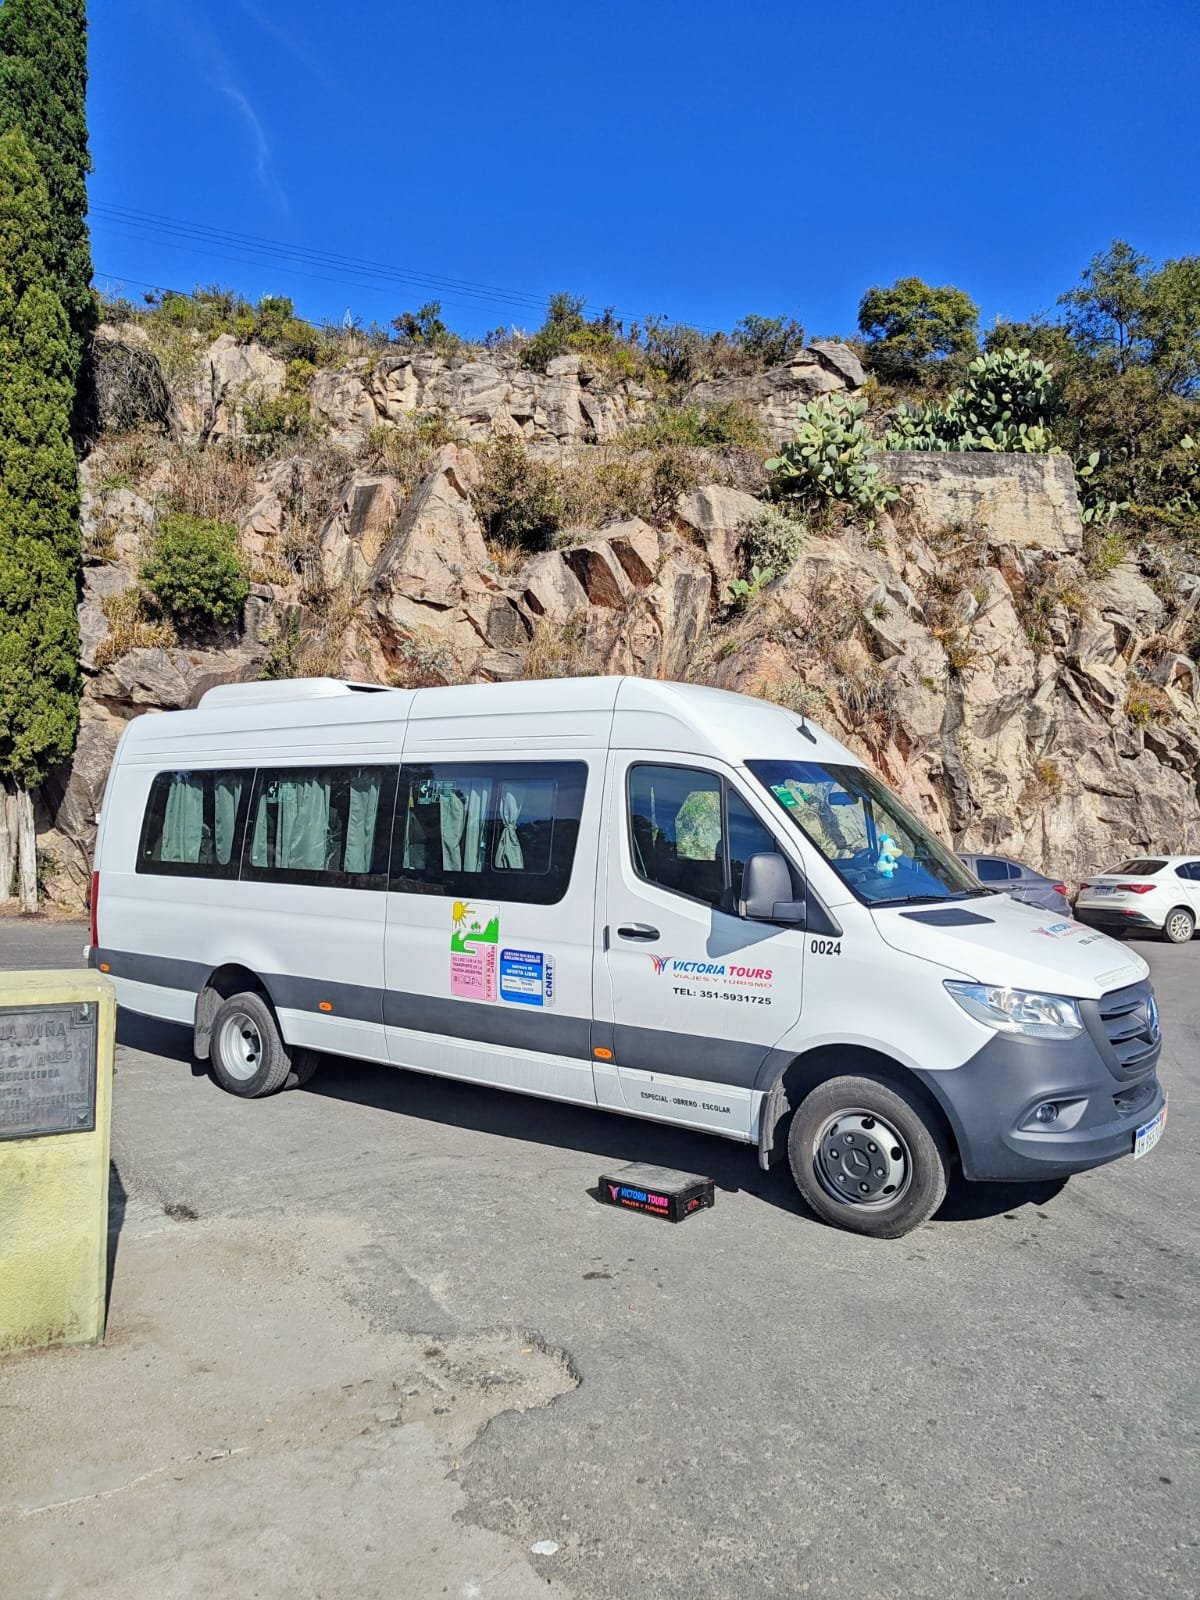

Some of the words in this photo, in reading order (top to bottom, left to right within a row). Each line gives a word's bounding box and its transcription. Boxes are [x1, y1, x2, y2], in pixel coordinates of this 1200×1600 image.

[810, 940, 841, 956] 0024
[672, 960, 726, 976] VICTORIA
[729, 966, 774, 980] TOURS
[545, 964, 553, 997] CNRT
[673, 973, 710, 982] VIAJES
[723, 979, 773, 988] TURISMO
[672, 987, 697, 997] TEL:
[700, 990, 772, 1005] 351-5931725
[640, 1092, 669, 1103] ESPECIAL
[673, 1097, 698, 1108] OBRERO
[702, 1102, 731, 1114] ESCOLAR
[620, 1187, 647, 1202] VICTORIA
[648, 1194, 668, 1207] TOURS
